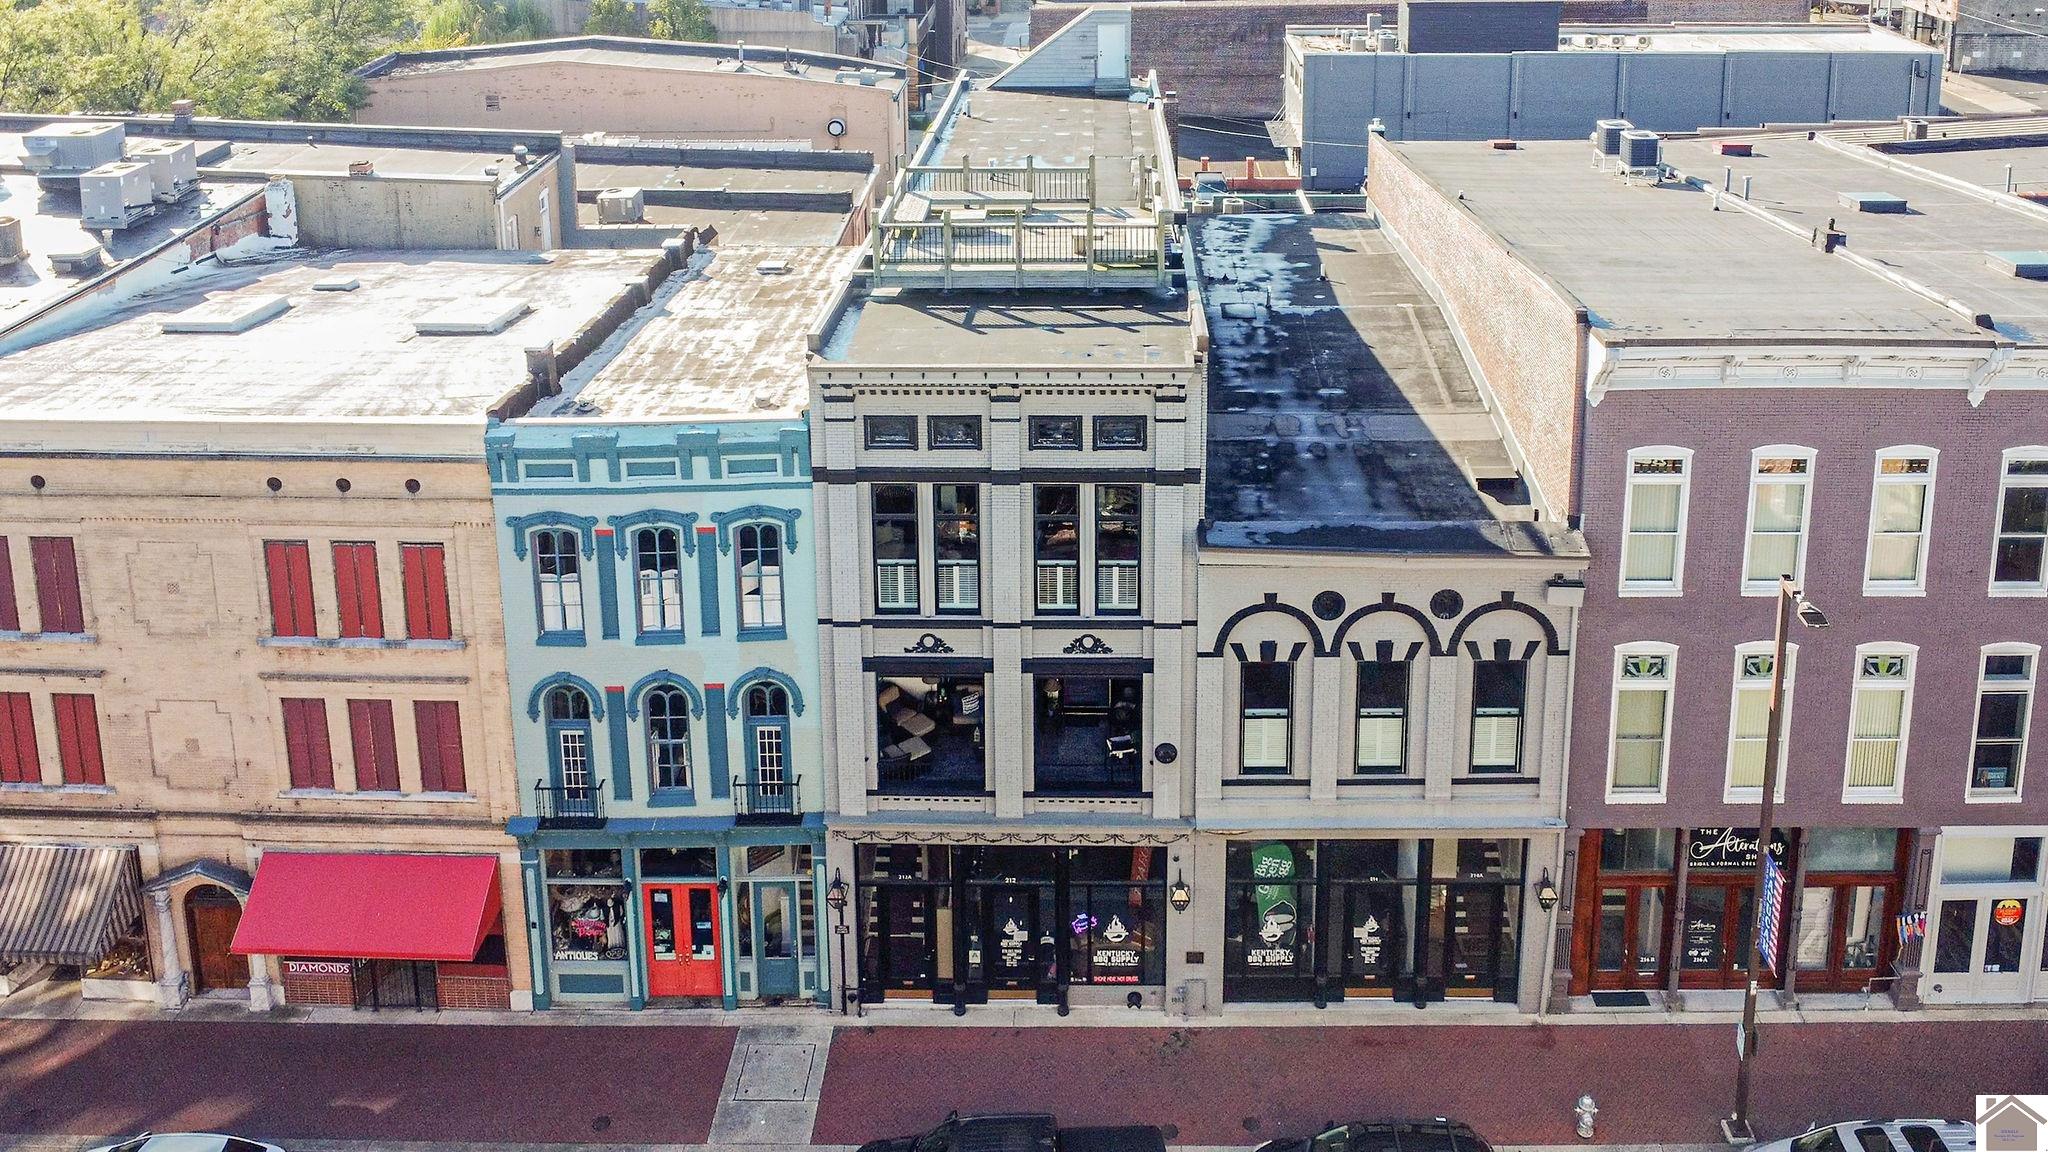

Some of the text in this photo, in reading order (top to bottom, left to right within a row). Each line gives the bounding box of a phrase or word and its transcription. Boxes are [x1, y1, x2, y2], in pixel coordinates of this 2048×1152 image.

[1690, 827, 1785, 859] Alteratns
[1254, 856, 1273, 877] Big
[555, 950, 599, 960] ANTIQUES
[1093, 955, 1140, 963] BBQ SUPPLY
[1265, 955, 1294, 963] SUPPLY
[289, 963, 351, 974] DIAMONDS
